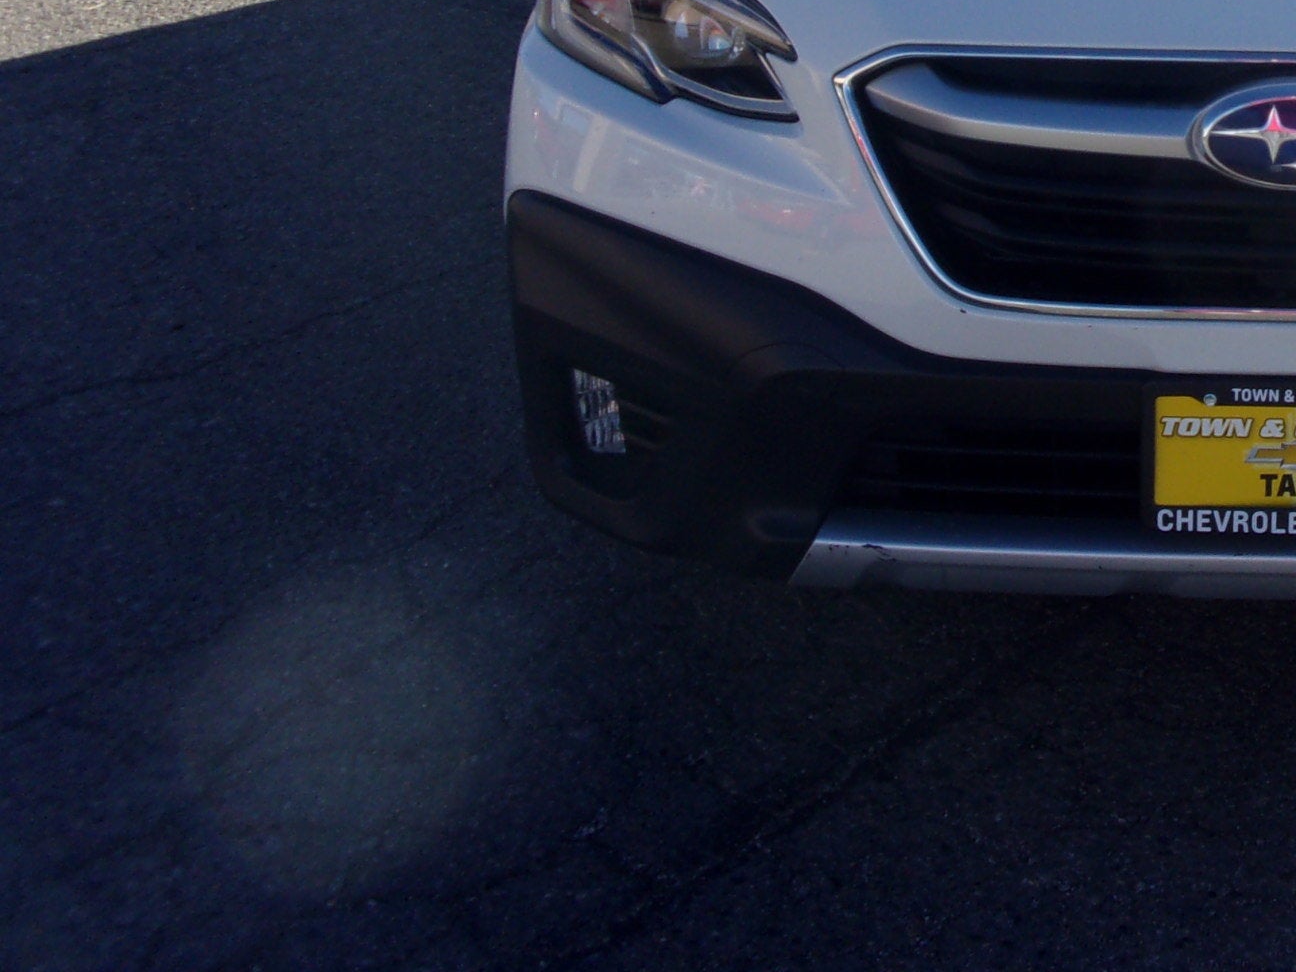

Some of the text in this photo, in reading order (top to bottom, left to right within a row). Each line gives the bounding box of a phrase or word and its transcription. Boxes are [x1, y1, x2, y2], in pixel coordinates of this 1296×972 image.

[1231, 388, 1281, 402] TOWN
[1284, 389, 1296, 403] &
[1160, 416, 1254, 438] TOWN
[1258, 417, 1285, 438] &
